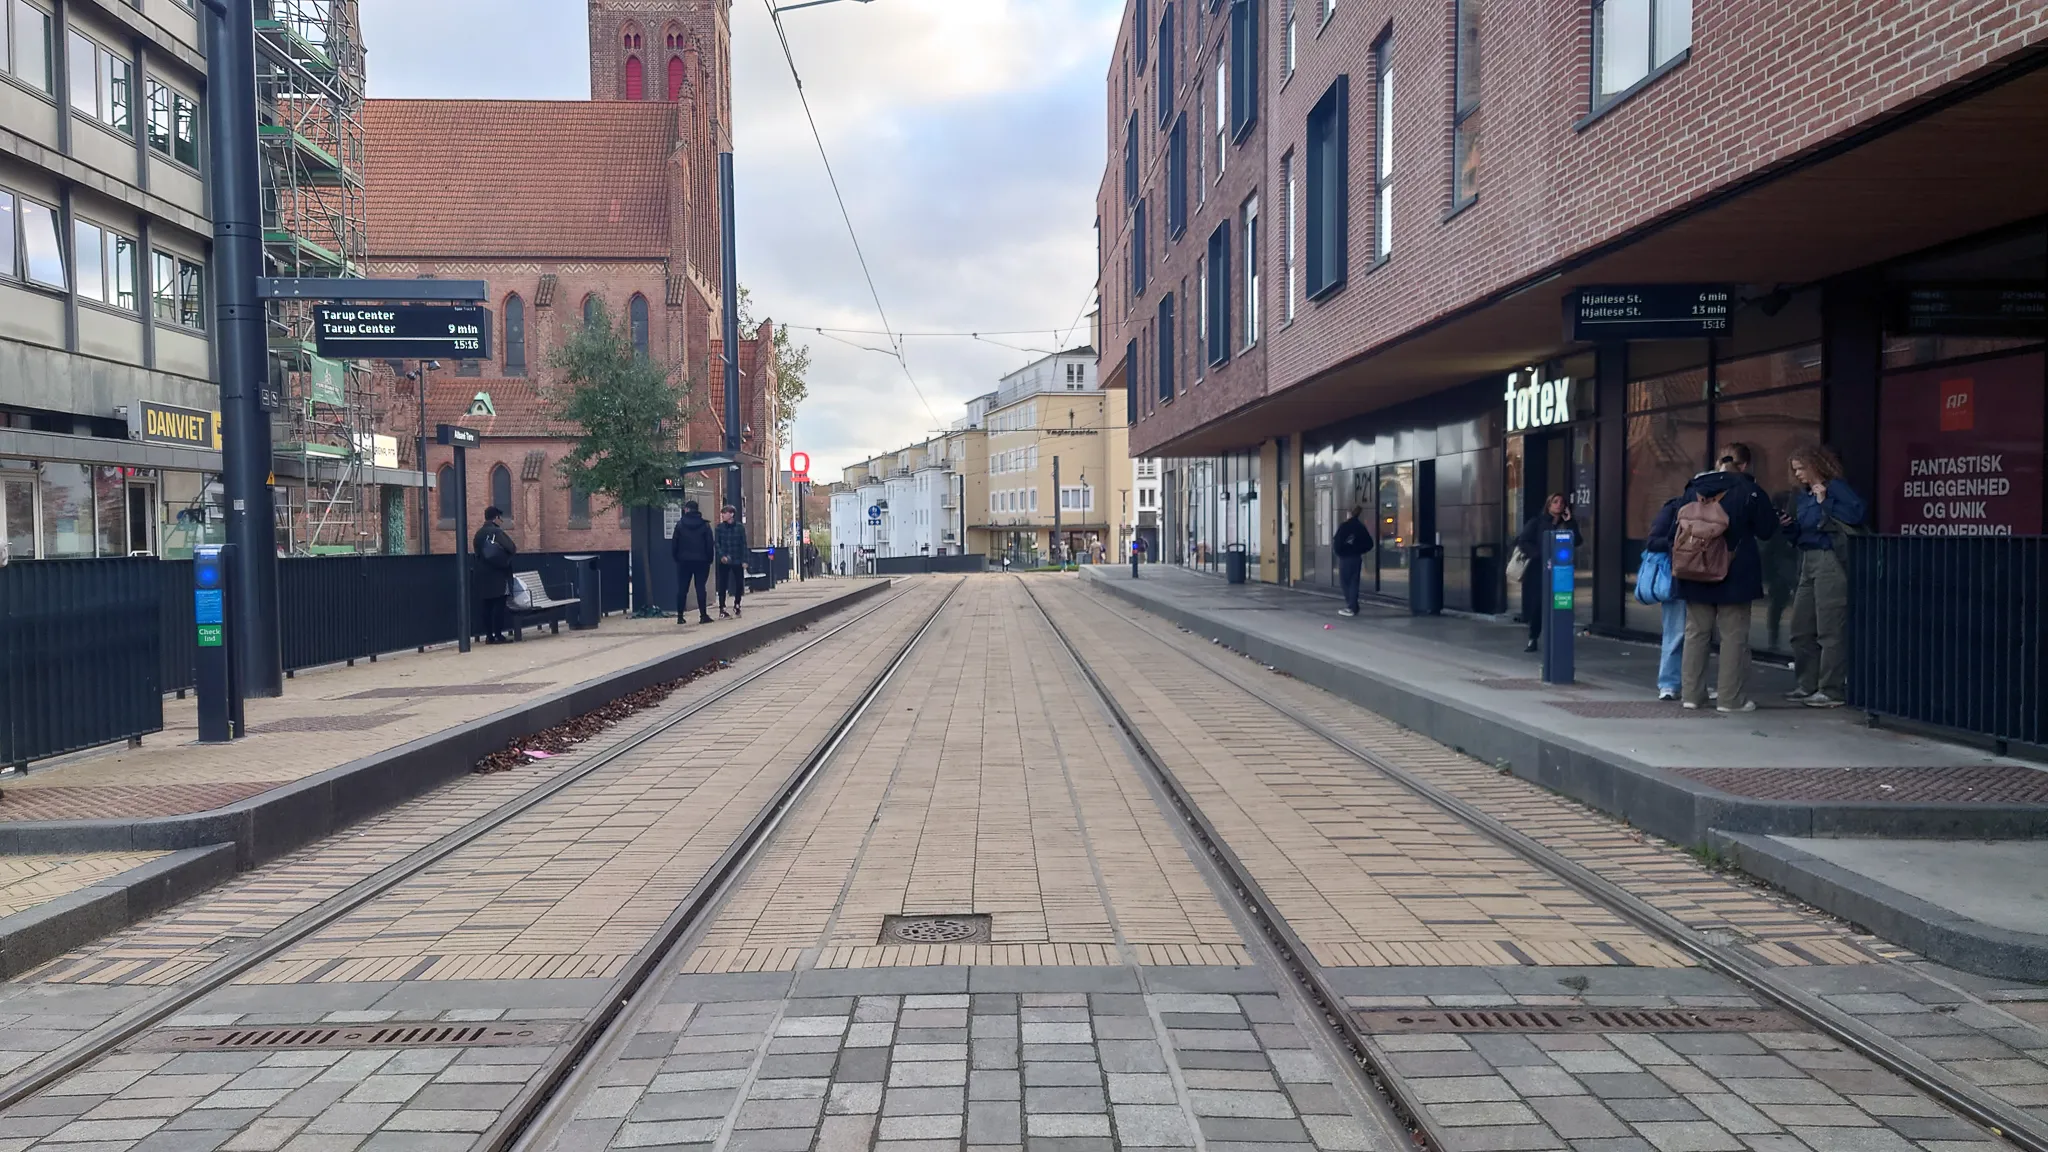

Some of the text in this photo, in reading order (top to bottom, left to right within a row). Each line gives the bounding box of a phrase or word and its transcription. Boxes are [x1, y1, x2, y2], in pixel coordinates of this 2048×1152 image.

[1582, 293, 1727, 305] Hjallese St. 6 min
[322, 310, 395, 321] Tarup Center
[1582, 305, 1726, 318] Hjallese St. 13 min
[323, 324, 478, 334] Tarup Center 9 min
[1702, 320, 1725, 329] 15:16
[454, 340, 479, 349] 15:16
[1504, 367, 1570, 432] føtex
[147, 409, 204, 441] DANVIET
[1911, 455, 2003, 476] FANTASTISK
[1904, 478, 2010, 497] BELIGGENHED
[1923, 501, 1987, 519] OG UNIK
